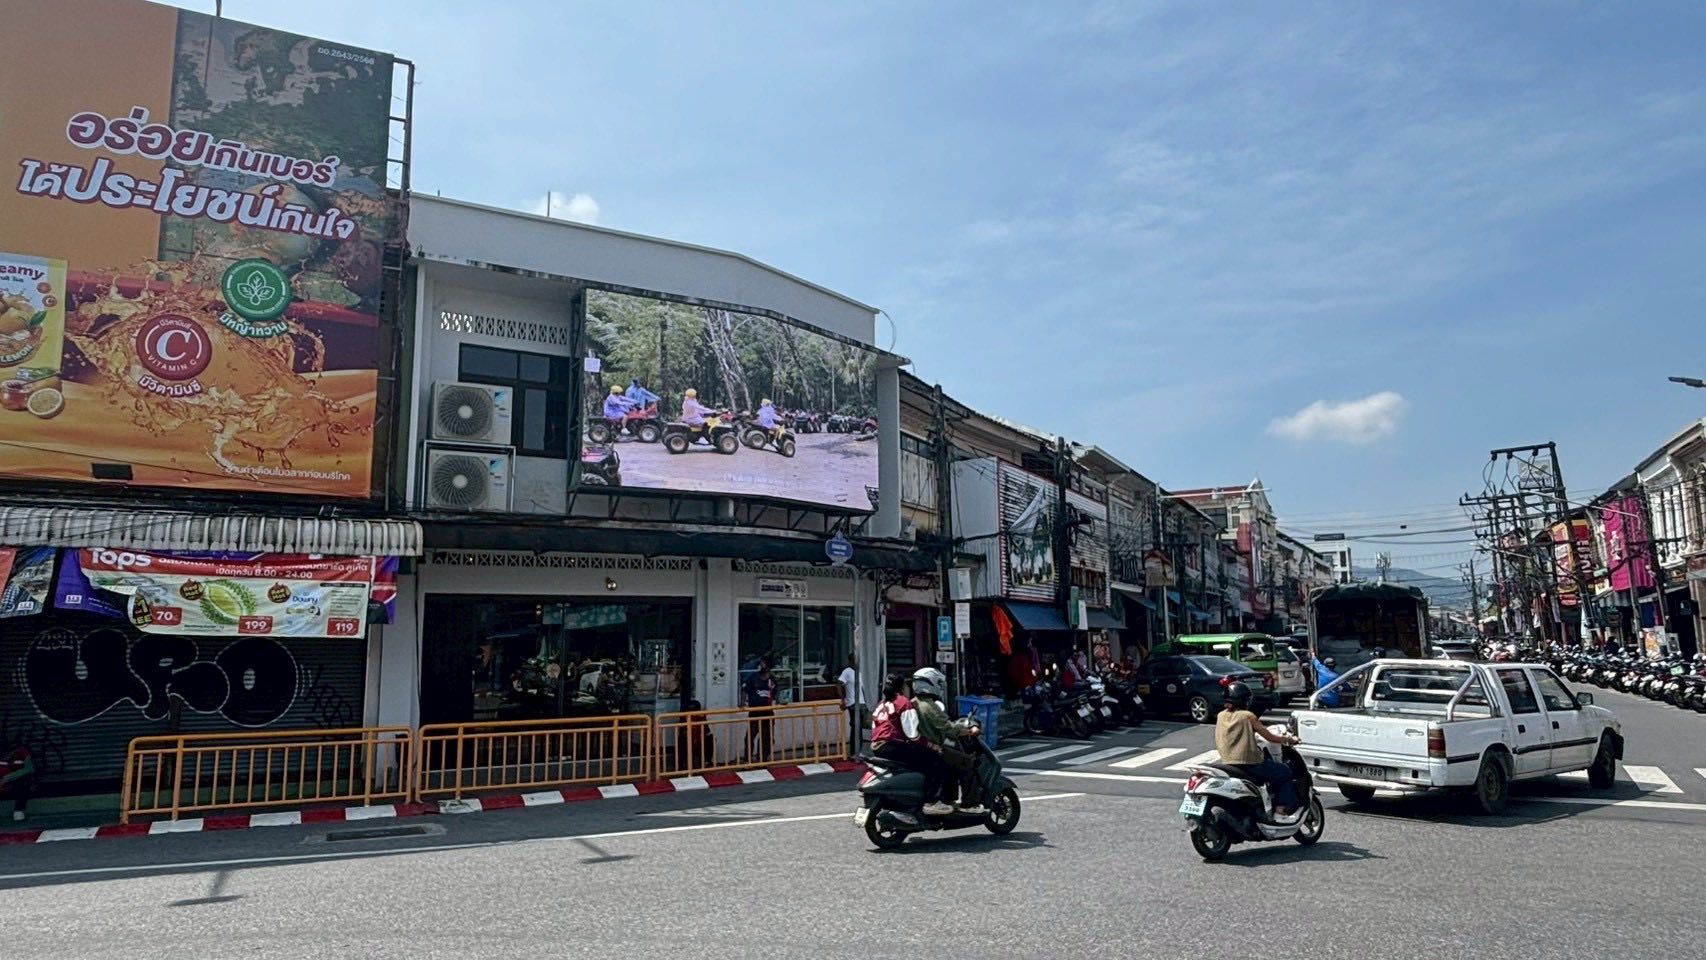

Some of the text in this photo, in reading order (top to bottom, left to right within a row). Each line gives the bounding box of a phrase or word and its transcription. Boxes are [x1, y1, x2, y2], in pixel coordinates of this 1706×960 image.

[66, 105, 341, 188] อร่อยเกินเบอร์
[16, 156, 357, 242] ได้ประโยชน์เกินใจ
[156, 329, 192, 361] C
[147, 354, 188, 371] VITAMIN
[139, 374, 202, 396] มีวิตามินซี
[91, 547, 151, 570] Tops
[285, 570, 313, 579] 24.00
[155, 611, 173, 621] 70
[244, 620, 268, 630] 199
[335, 622, 354, 632] 119
